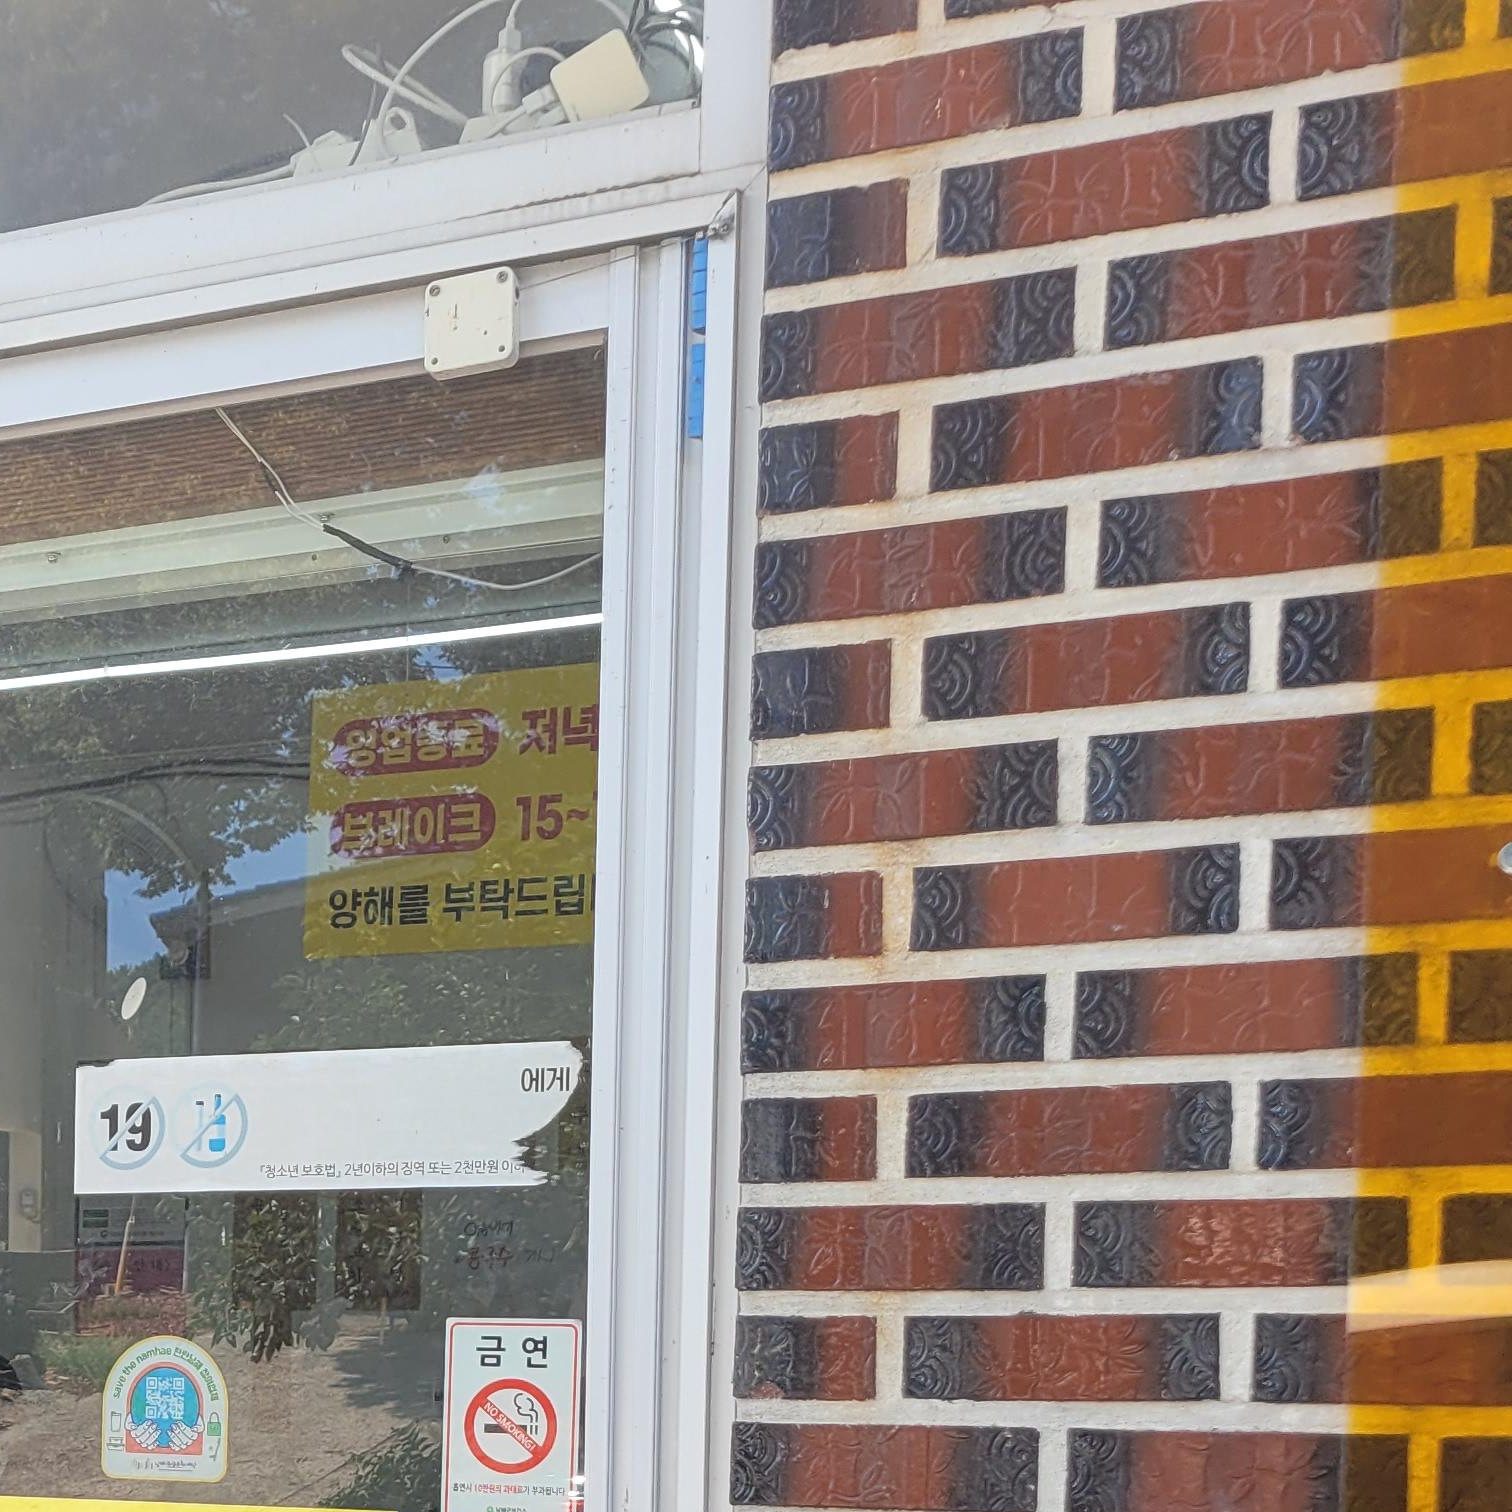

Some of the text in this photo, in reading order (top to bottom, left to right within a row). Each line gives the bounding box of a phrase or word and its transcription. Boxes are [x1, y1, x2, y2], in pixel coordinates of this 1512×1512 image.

[343, 803, 481, 850] 브레이크
[329, 873, 595, 928] 양해를 부탁드립
[520, 1066, 571, 1093] 에게
[99, 1102, 152, 1152] 19
[344, 1161, 399, 1177] 2년이하의
[401, 1160, 426, 1176] 징역
[428, 1160, 453, 1175] 또는
[455, 1159, 499, 1174] 2천만원
[122, 1361, 137, 1375] the
[136, 1347, 172, 1364] namhae
[483, 1402, 499, 1417] NO
